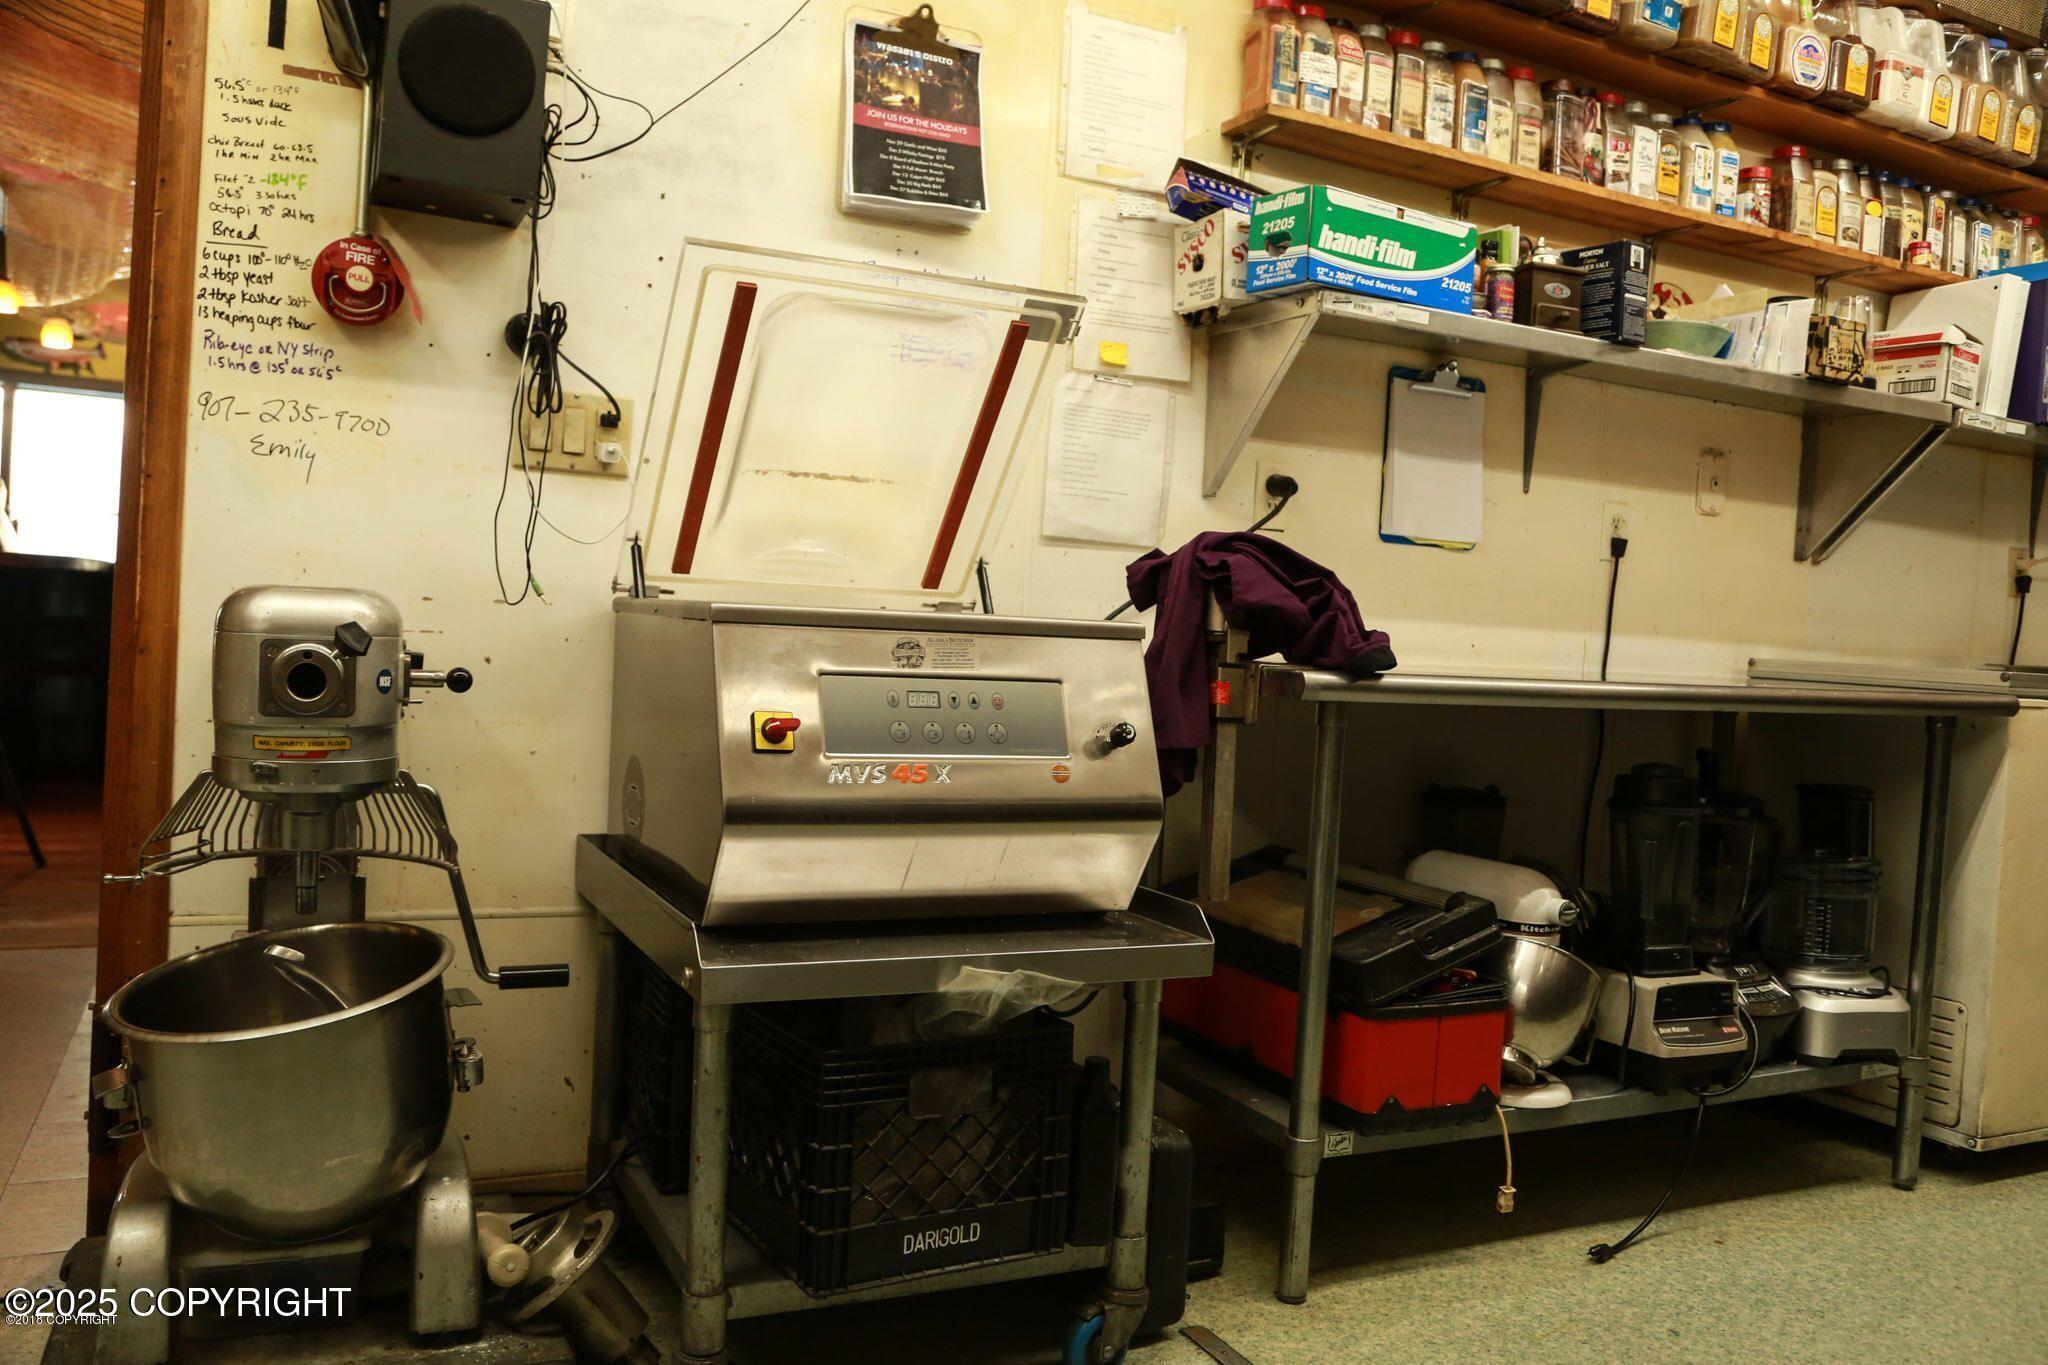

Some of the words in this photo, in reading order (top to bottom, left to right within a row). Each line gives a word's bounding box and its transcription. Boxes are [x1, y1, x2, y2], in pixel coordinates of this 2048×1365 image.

[222, 112, 252, 123] Sous
[867, 109, 886, 120] JOIN
[887, 113, 897, 121] US
[899, 115, 914, 125] FOR
[915, 118, 929, 128] THE
[930, 121, 968, 135] HOLIDAYS
[209, 202, 251, 219] Octopi
[281, 207, 297, 219] 24
[1254, 191, 1306, 216] handi-film
[212, 220, 260, 240] Bread
[1261, 216, 1296, 235] 21205
[202, 246, 211, 260] 6
[340, 241, 348, 249] In
[350, 243, 371, 253] Case
[1178, 219, 1215, 275] SYSCO
[1318, 224, 1417, 270] handi-film
[1579, 248, 1604, 258] MORTON
[345, 251, 376, 266] FIRE
[1595, 261, 1610, 269] SALT
[199, 266, 210, 279] 2
[212, 268, 239, 286] tbsp
[243, 272, 273, 287] yeast
[348, 273, 370, 284] PULL
[1253, 279, 1266, 287] Food
[1266, 275, 1285, 285] Service
[1285, 273, 1296, 281] Film
[1356, 274, 1374, 287] Food
[1375, 279, 1402, 293] Service
[1403, 286, 1418, 297] Film
[1441, 277, 1472, 294] 21205
[197, 287, 208, 300] 2
[208, 289, 236, 308] tbsp
[198, 305, 208, 318] 13
[213, 306, 254, 332] heaping
[257, 315, 282, 331] cups
[287, 315, 316, 330] flour
[278, 341, 299, 358] NY
[208, 356, 224, 369] 1.5
[227, 358, 246, 371] hrs
[249, 361, 261, 374] @
[250, 434, 317, 484] Emily
[379, 675, 392, 688] NSF
[827, 763, 887, 784] MVS
[891, 763, 929, 784] 45
[933, 764, 953, 784] X
[903, 1222, 981, 1255] DARIGOLD
